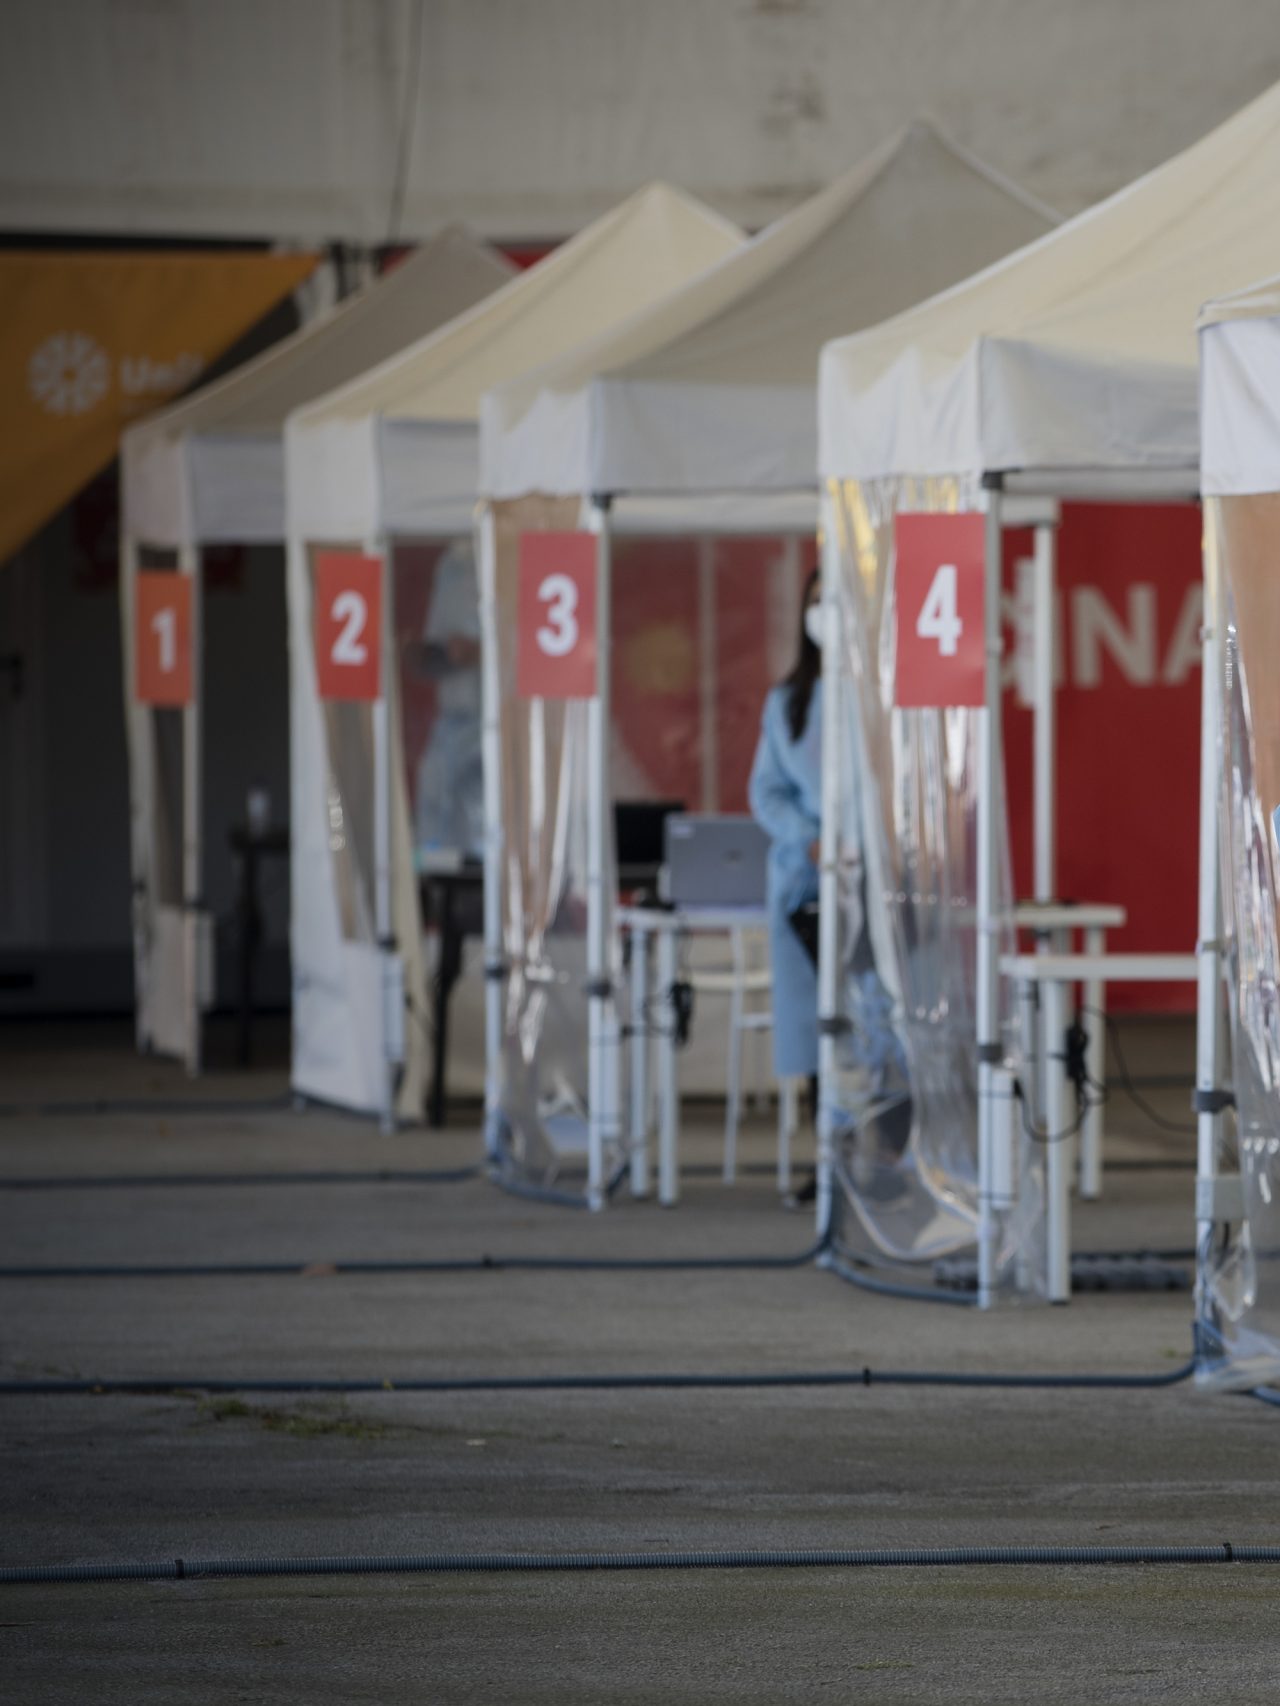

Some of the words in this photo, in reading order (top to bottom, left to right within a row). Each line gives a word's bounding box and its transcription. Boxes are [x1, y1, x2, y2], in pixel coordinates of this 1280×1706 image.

[152, 607, 176, 672] 1
[331, 590, 367, 666] 2
[537, 574, 578, 657] 3
[916, 563, 962, 657] 4
